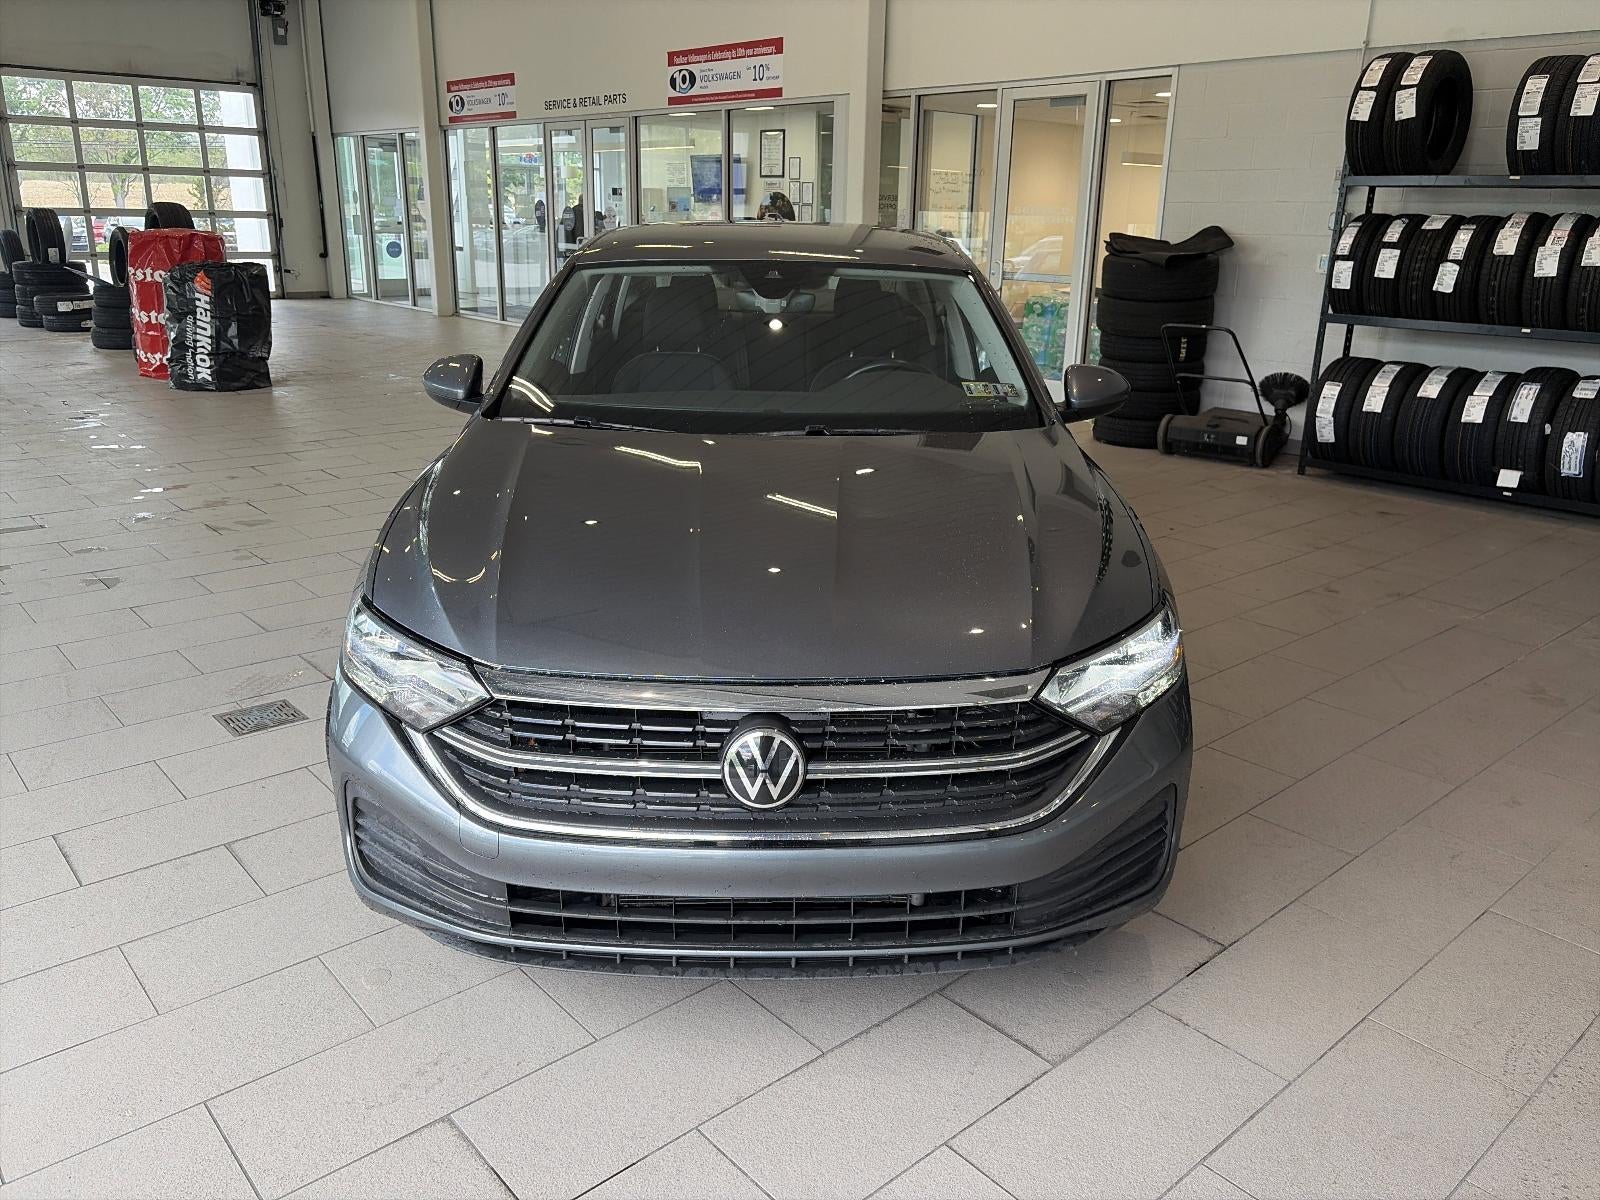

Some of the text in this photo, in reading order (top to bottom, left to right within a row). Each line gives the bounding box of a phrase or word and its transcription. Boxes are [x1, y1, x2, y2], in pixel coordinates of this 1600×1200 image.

[688, 53, 707, 63] Volkswagen
[712, 50, 732, 61] Celebrating
[737, 48, 746, 57] 10th
[673, 70, 692, 92] 10
[700, 70, 742, 83] VOLKSWAGEN
[544, 92, 627, 111] SERVICE & RETAIL PARTS
[185, 315, 195, 347] driving
[724, 731, 804, 808] VW
